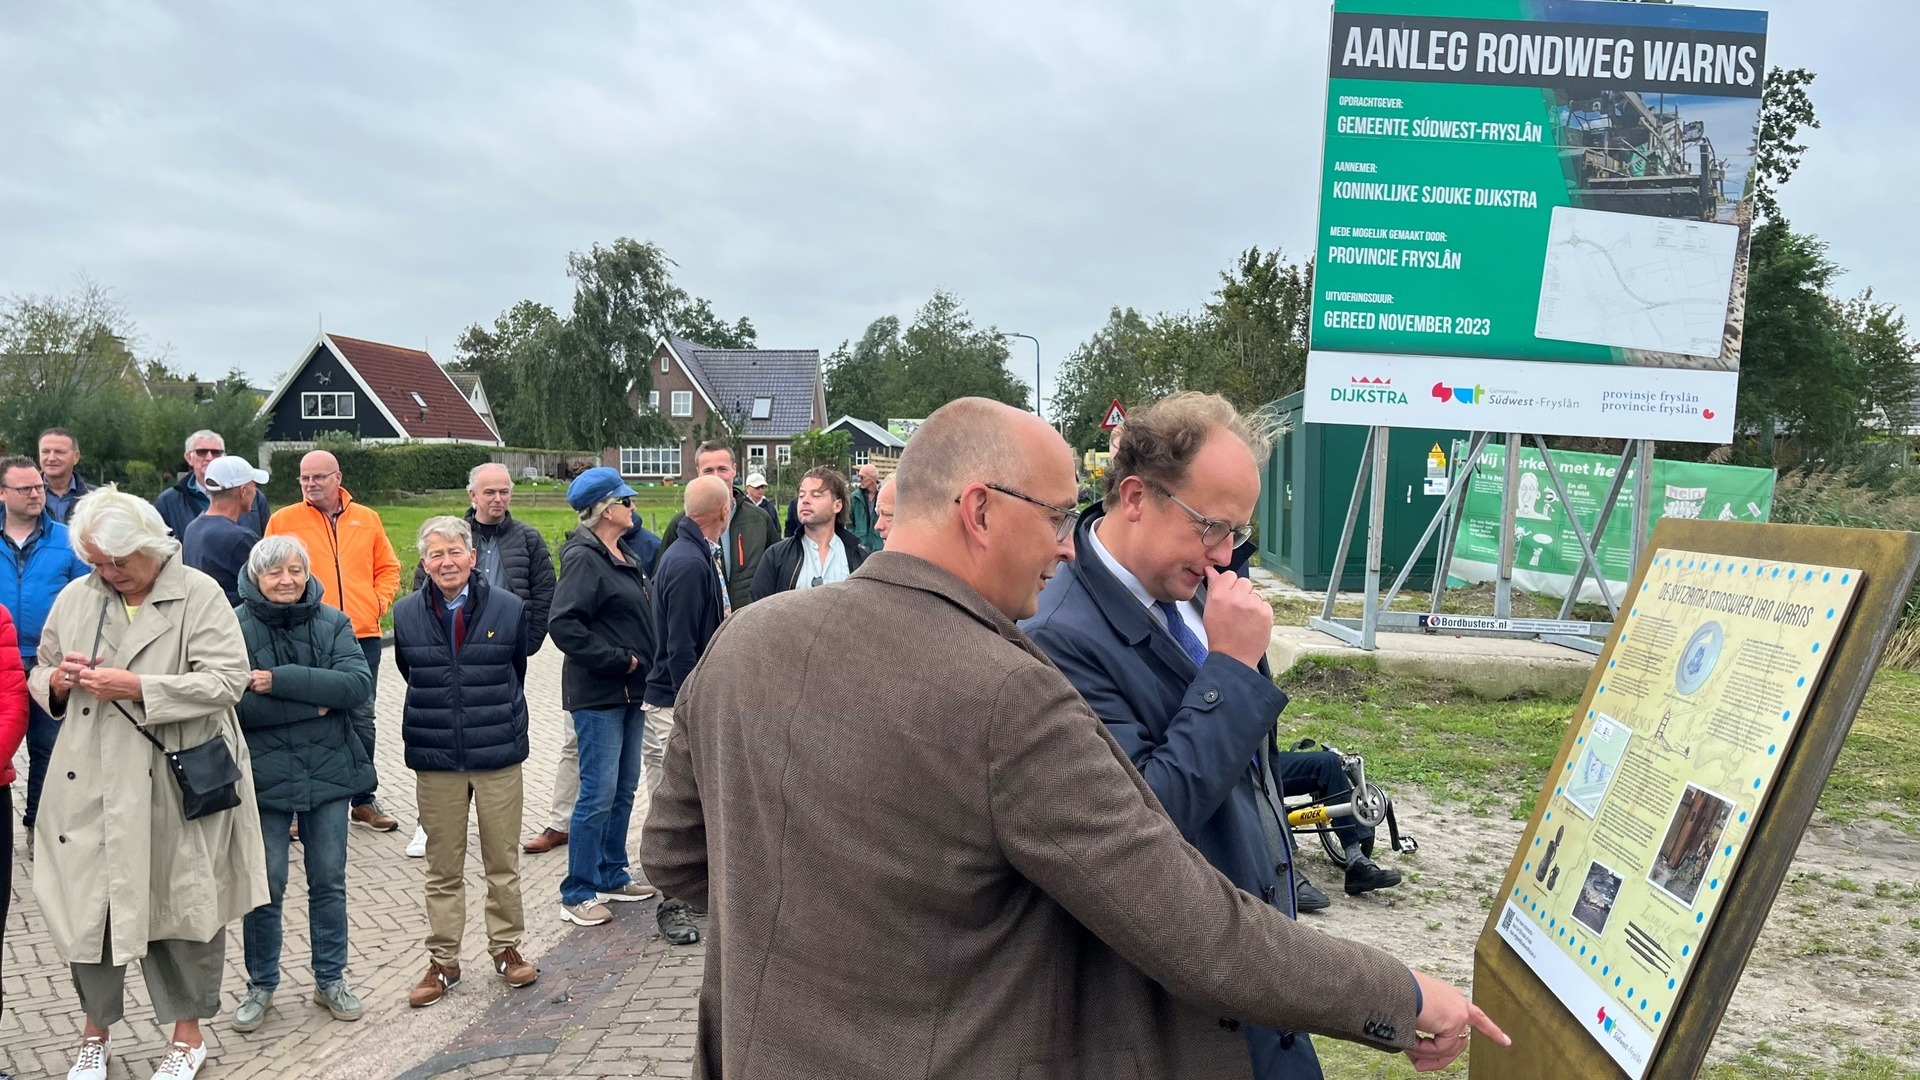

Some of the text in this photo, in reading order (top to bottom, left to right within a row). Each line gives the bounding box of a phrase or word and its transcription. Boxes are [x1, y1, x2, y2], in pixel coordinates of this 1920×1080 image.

[1342, 27, 1756, 86] AANLEG RONDWEG WARNS
[1339, 96, 1403, 108] OPDRACHTGEVER:
[1337, 116, 1542, 142] GEMEENTE SÚDWEST-FRYSLÂN
[1335, 161, 1377, 173] AANNEMER:
[1333, 181, 1537, 208] KONINKLIJKE SJOUKE DIJKSTRA
[1330, 226, 1447, 242] MEDE MOGELIJK GEMAAKT DOOR:
[1328, 246, 1461, 270] PROVINCIE FRYSLÂN
[1325, 291, 1394, 304] UITVOERINGSDUUR:
[1324, 311, 1490, 336] GEREED NOVEMBER 2023
[1331, 388, 1408, 404] DIJKSTRA
[1603, 390, 1699, 404] provinsje fryslân
[1601, 401, 1698, 416] provincie fryslân
[1560, 463, 1589, 475] met
[1593, 462, 1635, 479] hen
[1669, 486, 1701, 499] hein
[1658, 583, 1814, 628] DE SYTZAMA STINSWIER VAN WARNS
[1442, 617, 1507, 630] Bordbusters.nl
[1300, 809, 1321, 820] RIDER
